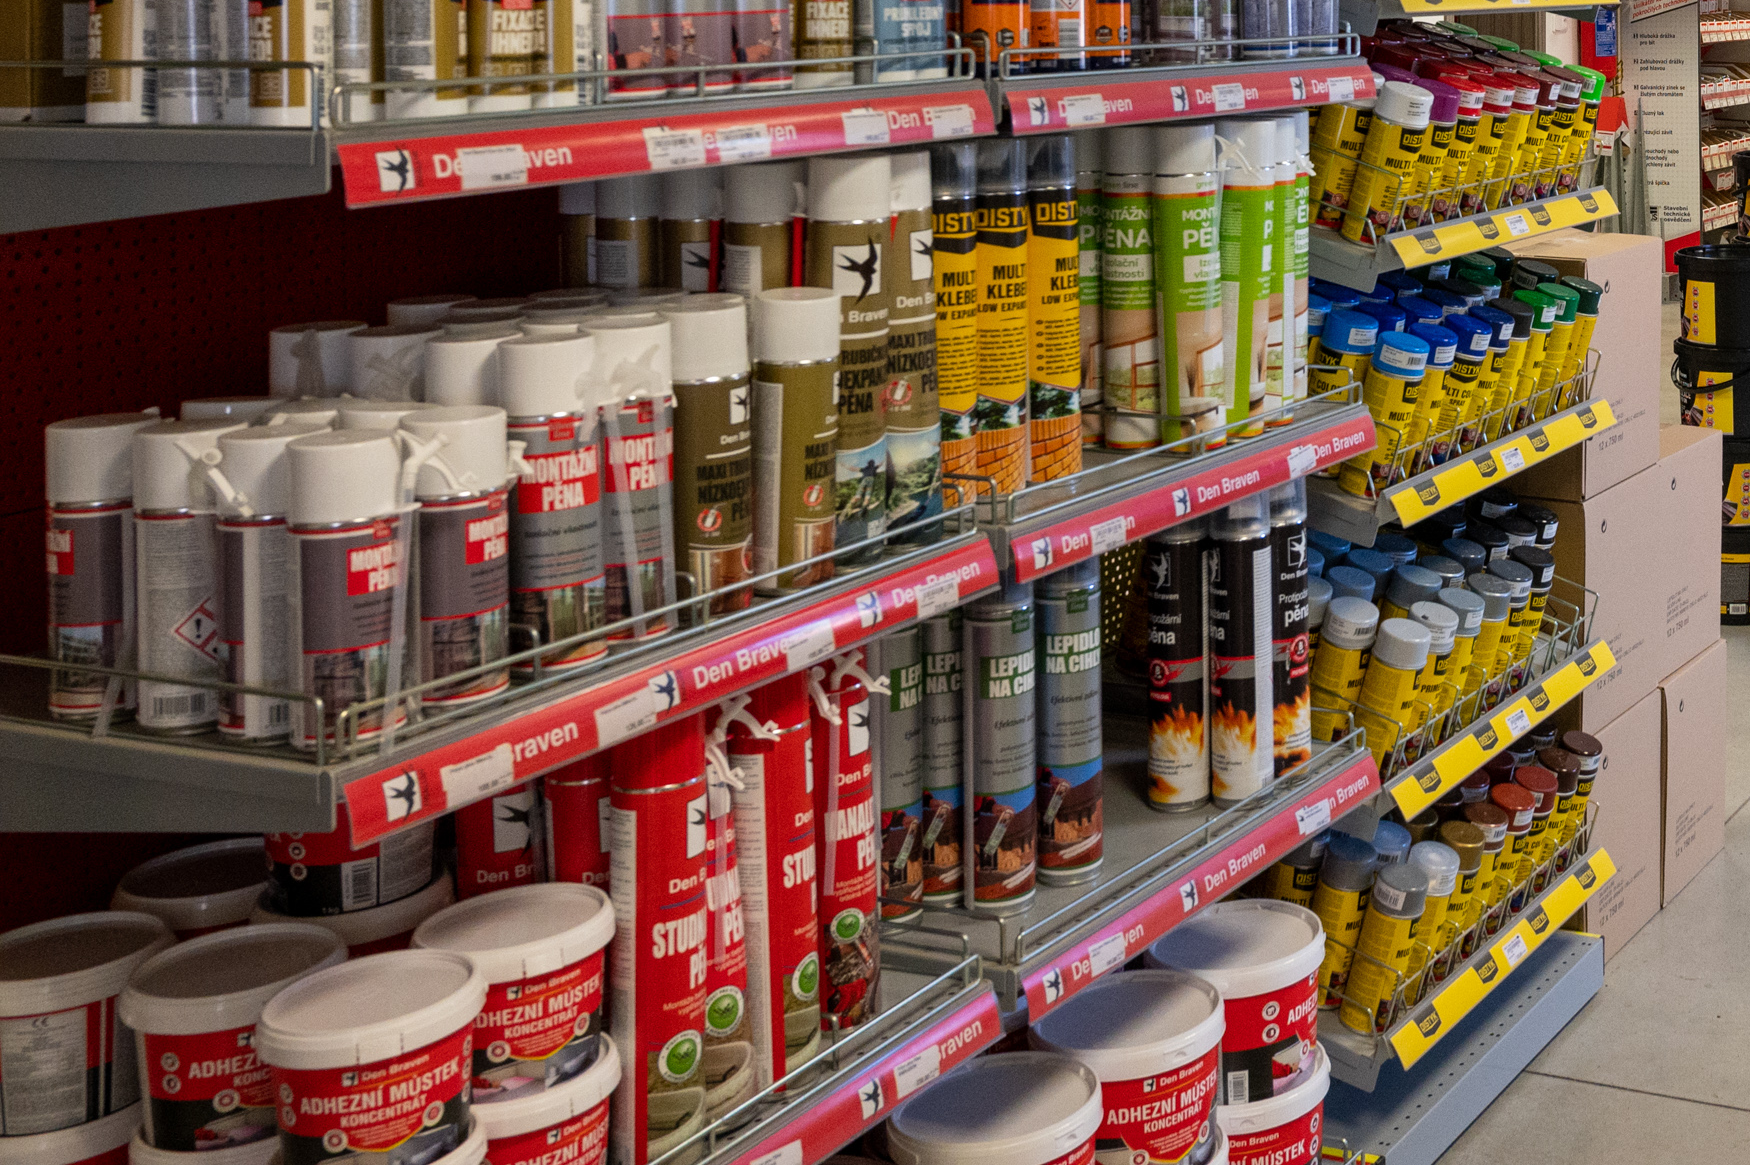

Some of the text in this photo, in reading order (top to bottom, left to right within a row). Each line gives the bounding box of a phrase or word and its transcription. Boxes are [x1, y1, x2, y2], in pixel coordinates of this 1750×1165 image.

[888, 109, 921, 130] Den
[1385, 156, 1412, 170] MULTI
[896, 295, 922, 309] Den
[1041, 293, 1061, 305] LOW
[1313, 429, 1365, 460] Den Braven
[541, 477, 585, 511] PĚNA
[1197, 468, 1261, 504] Den Braven
[1061, 533, 1088, 554] Den
[694, 662, 733, 690] Den
[1045, 655, 1065, 674] NA
[925, 674, 947, 695] NA
[988, 678, 1008, 699] NA
[1336, 773, 1370, 805] Braven
[1204, 841, 1267, 893] Den Braven
[668, 874, 697, 895] Den
[504, 1007, 579, 1039] KONCENTRÁT
[1159, 1061, 1205, 1088] Den Braven
[300, 1083, 386, 1116] ADHEZNÍ
[340, 1093, 429, 1128] KONCENTRÁT
[1106, 1090, 1177, 1125] ADHEZNÍ
[1143, 1100, 1203, 1134] KONCENTRÁT
[1229, 1132, 1280, 1148] Den Braven
